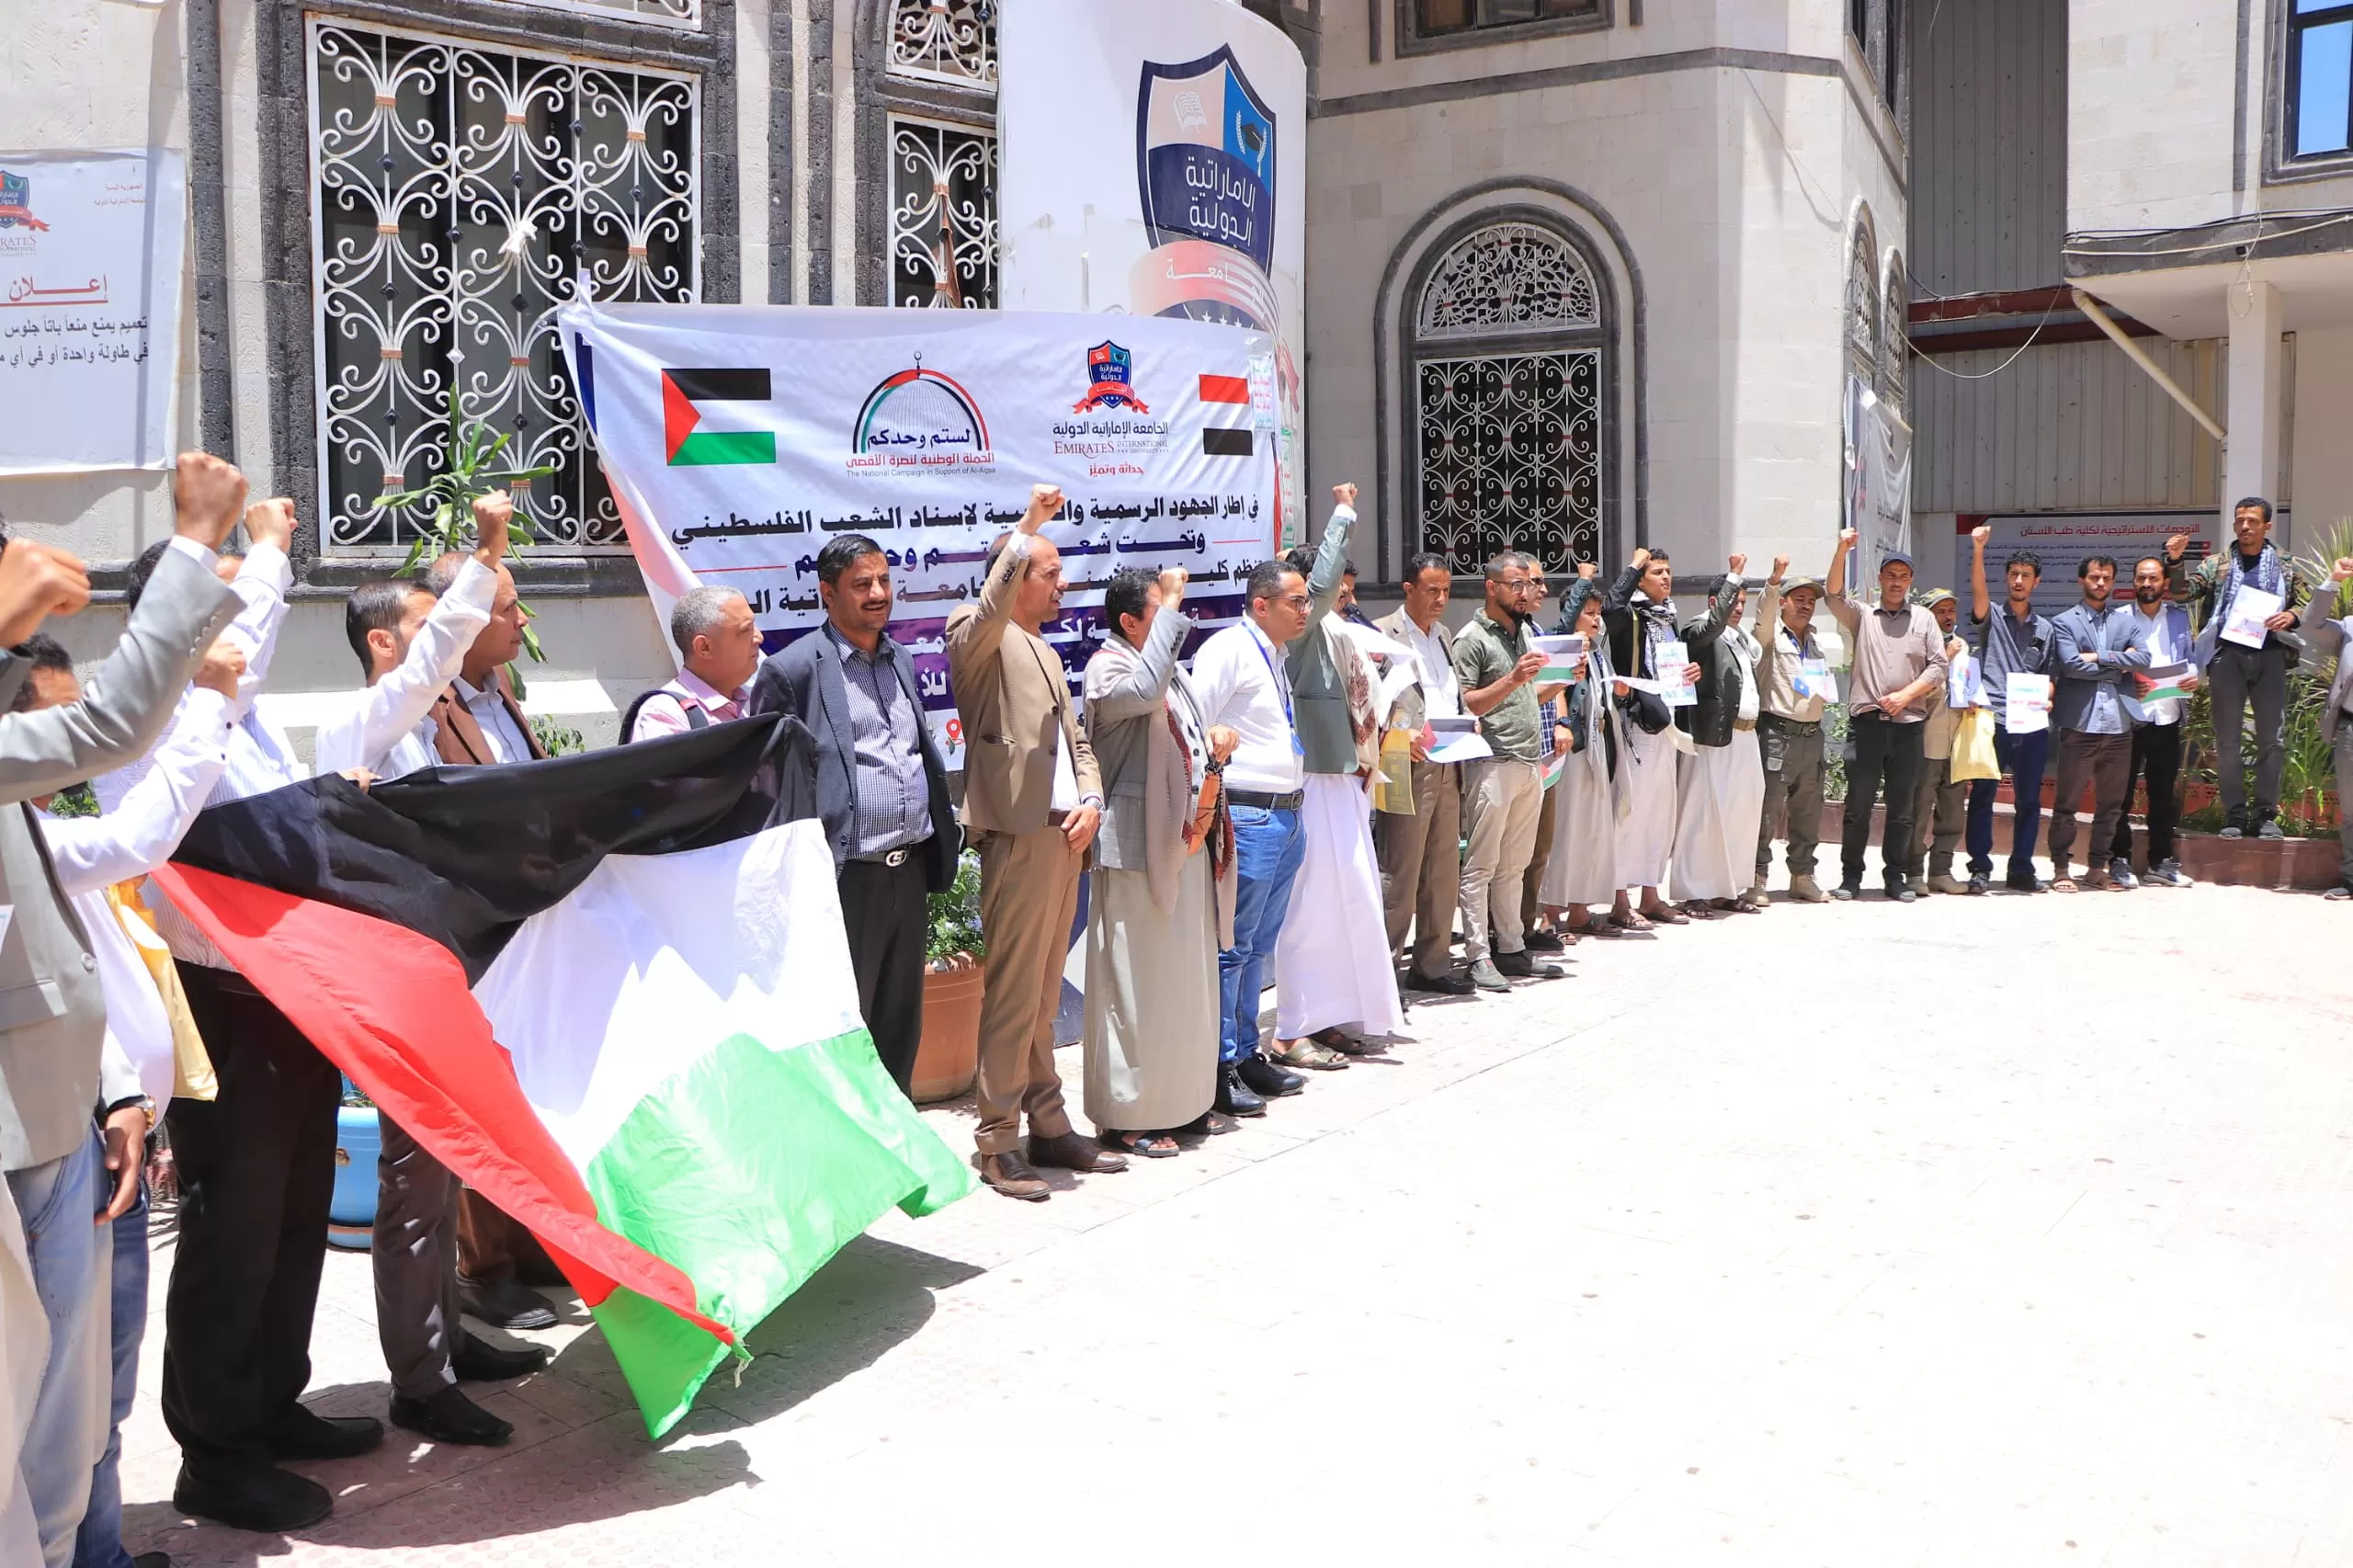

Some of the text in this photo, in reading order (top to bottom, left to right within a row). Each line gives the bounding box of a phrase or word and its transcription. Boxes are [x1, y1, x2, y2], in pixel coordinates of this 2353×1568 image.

[1189, 196, 1253, 247] الدولية
[0, 234, 37, 246] RATES
[9, 273, 108, 302] إعلان
[5, 320, 40, 337] جلوس
[92, 317, 116, 337] يمنع
[119, 316, 148, 337] تعميم
[10, 346, 24, 368] أي
[28, 345, 44, 368] في
[48, 345, 59, 365] أو
[63, 346, 95, 364] واحدة
[98, 342, 130, 363] طاولة
[133, 341, 149, 366] في
[867, 428, 971, 449] لستم وحدكم
[1052, 421, 1168, 439] الجامعة الإماراتية الدولية
[846, 452, 995, 468] الحملة الوطنية لنصرة الأقصى
[1053, 441, 1115, 459] EMIRATES
[861, 469, 890, 477] National
[891, 469, 925, 479] Campaign
[935, 468, 961, 476] Support
[970, 467, 995, 475] Al-Aqsa
[1119, 461, 1144, 475] حداثة
[671, 494, 1258, 551] في إطار الجهود الرسمية والبية لإسناد الشعب الفلسطيني
[795, 529, 1206, 582] وتحت شع تم وحم
